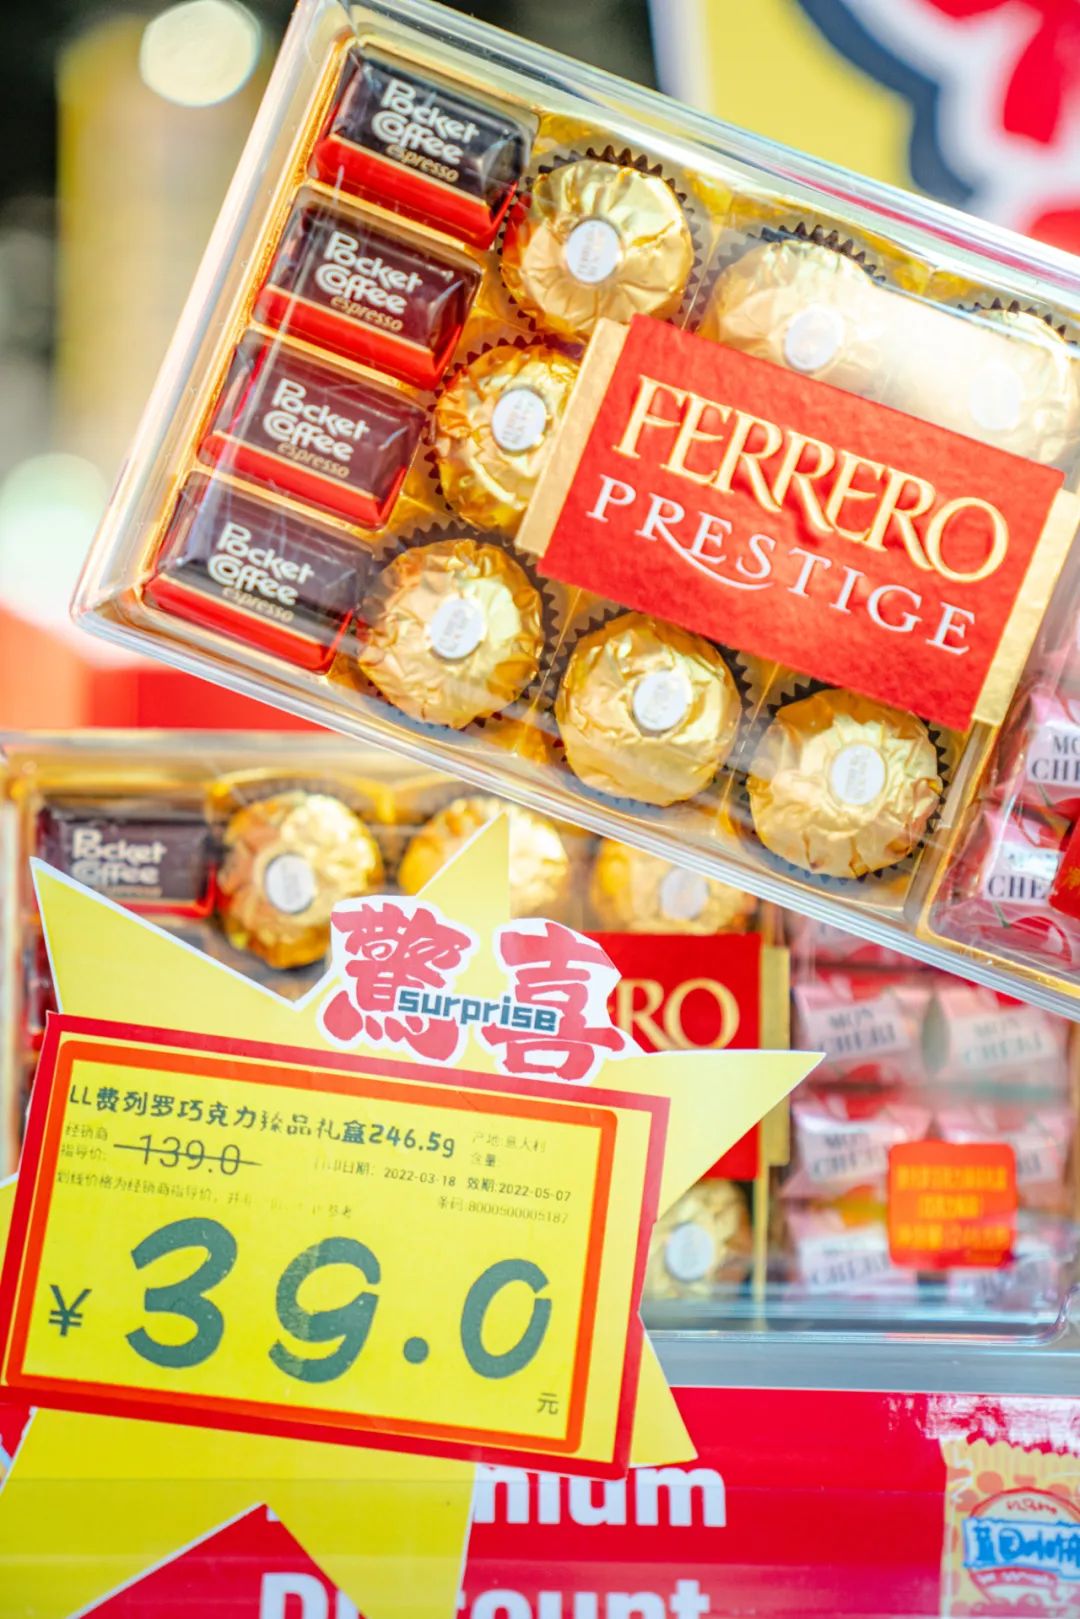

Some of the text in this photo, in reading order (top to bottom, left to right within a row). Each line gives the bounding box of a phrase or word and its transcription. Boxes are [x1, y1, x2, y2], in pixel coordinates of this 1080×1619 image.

[382, 78, 479, 143] Pocket
[371, 111, 464, 165] Coffee
[386, 144, 459, 183] espresso
[324, 231, 423, 293] Pocket
[315, 264, 407, 315] Coffee
[331, 296, 403, 331] espresso
[271, 378, 370, 440] Pocket
[263, 412, 354, 462] Coffee
[277, 442, 349, 478] espresso
[612, 374, 1008, 583] FERRERO
[217, 522, 314, 584] Pocket
[586, 474, 975, 656] PRESTIGE
[208, 554, 298, 606] Coffee
[1053, 735, 1080, 756] MO
[73, 829, 167, 864] Pocket
[71, 861, 159, 885] Coffee
[323, 903, 625, 1080] 驚喜
[398, 988, 557, 1032] surprise
[608, 978, 740, 1050] RO
[139, 1134, 242, 1177] 139.0
[384, 1167, 457, 1187] 2022-03-18
[125, 1216, 552, 1383] 39.0
[536, 1391, 559, 1415] 元
